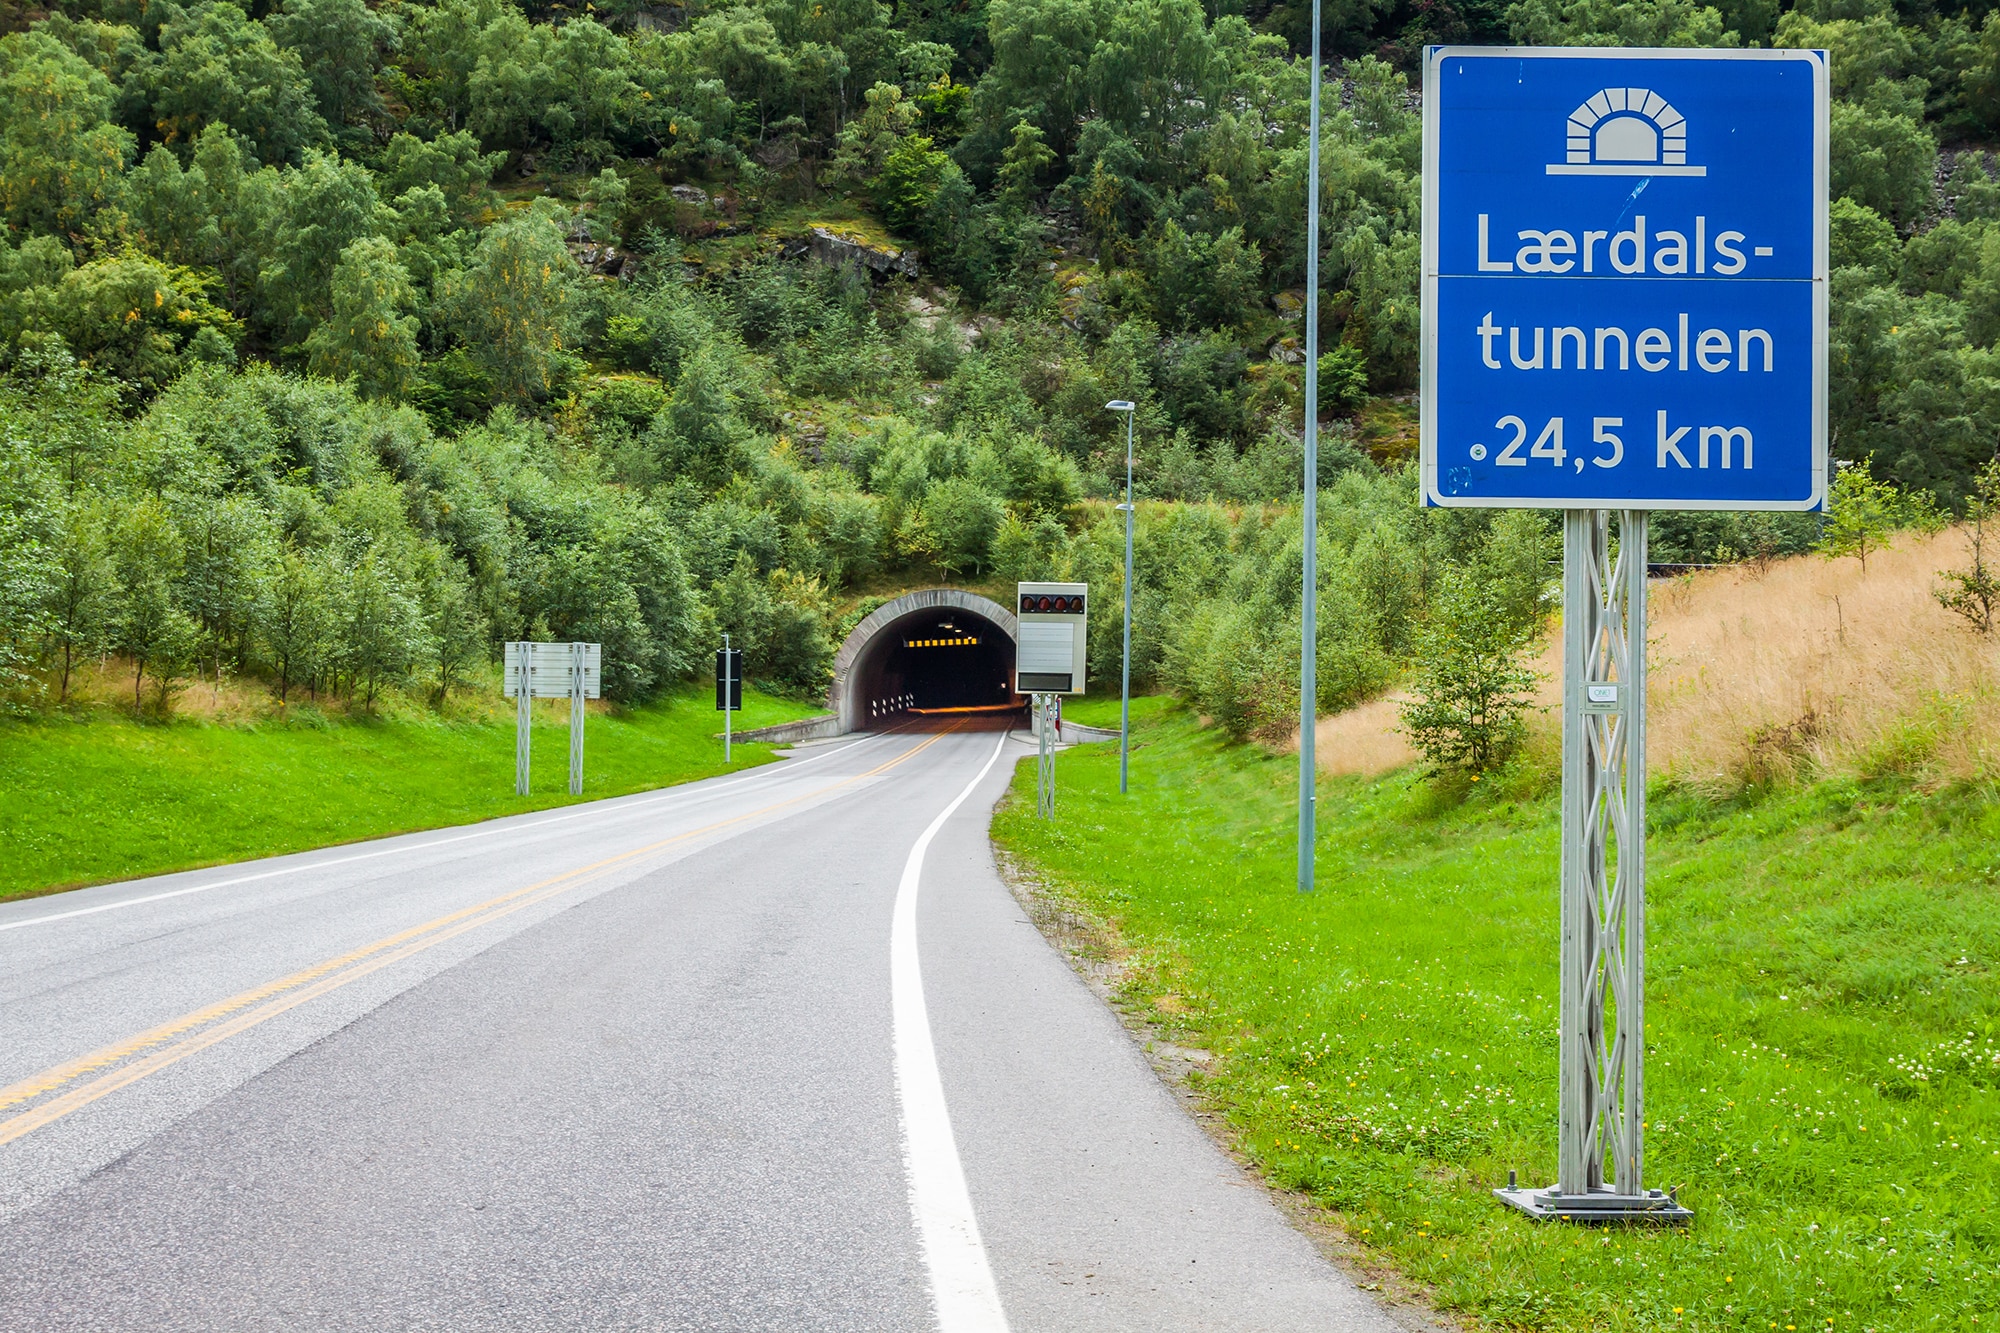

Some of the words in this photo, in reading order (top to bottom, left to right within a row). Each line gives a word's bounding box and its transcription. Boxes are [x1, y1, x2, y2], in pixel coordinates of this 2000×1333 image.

[1477, 213, 1774, 275] Lærdals-
[1476, 311, 1773, 373] tunnelen
[1495, 414, 1624, 475] 24,5
[1656, 409, 1753, 470] km
